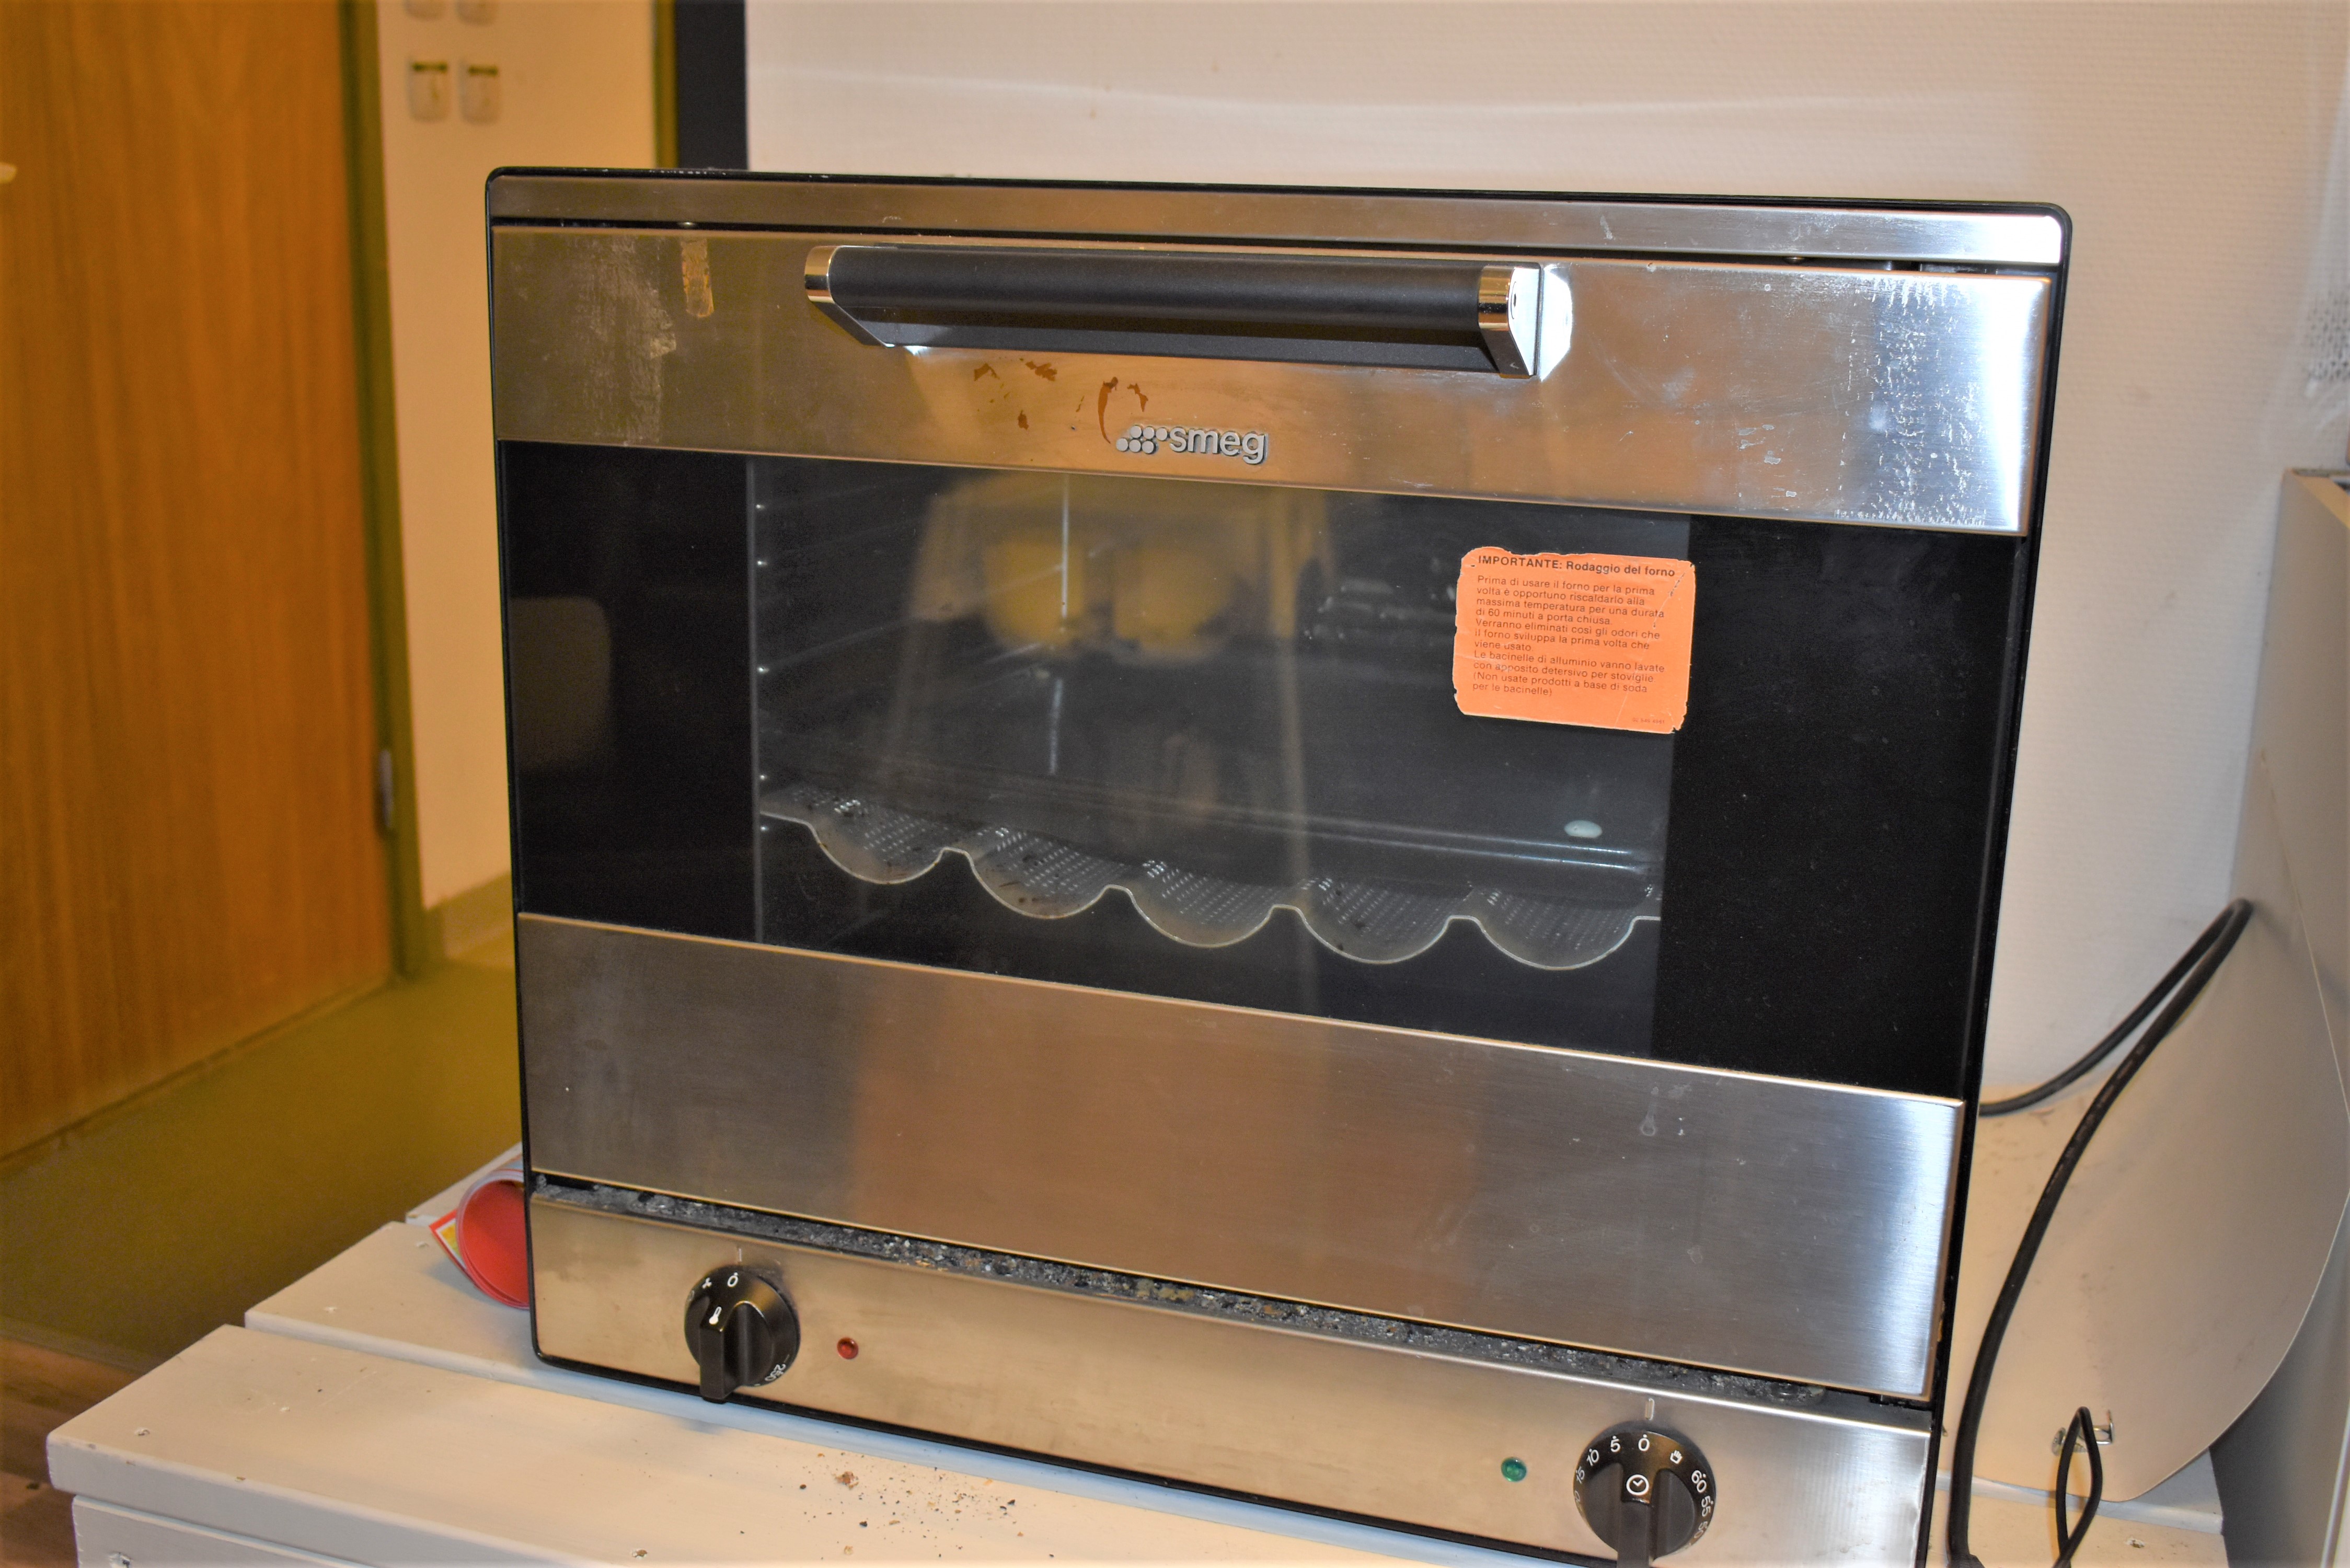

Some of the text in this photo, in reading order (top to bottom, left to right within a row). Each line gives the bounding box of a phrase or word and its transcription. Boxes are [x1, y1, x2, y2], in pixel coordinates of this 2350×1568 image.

[1169, 426, 1268, 465] smeg
[1478, 555, 1675, 577] IMPORTANTE: Rodaggio del forno
[1477, 575, 1506, 585] Prima
[1562, 581, 1589, 591] forno
[1593, 585, 1609, 594] per
[1513, 590, 1566, 599] opportuno
[1570, 593, 1623, 604] riscaldarlo
[1476, 598, 1520, 607] massima
[1524, 601, 1585, 612] temperatura
[1631, 608, 1664, 618] durata
[1488, 608, 1500, 617] 60
[1503, 610, 1534, 619] minuti
[1547, 614, 1573, 622] porta
[1476, 618, 1522, 629] Verranno
[1525, 622, 1568, 632] eliminati
[1595, 627, 1607, 637] gli
[1611, 629, 1638, 637] odori
[1641, 631, 1660, 639] che
[1474, 640, 1500, 649] viene
[1484, 629, 1511, 639] forno
[1514, 631, 1555, 643] sviluppa
[1559, 635, 1567, 643] la
[1571, 637, 1599, 645] prima
[1603, 639, 1627, 648] volta
[1474, 650, 1486, 659] Le
[1489, 651, 1534, 662] bacinelle
[1550, 656, 1597, 667] alluminio
[1634, 662, 1665, 672] lavate
[1495, 664, 1538, 673] apposito
[1542, 666, 1588, 677] detersivo
[1473, 672, 1497, 681] (Non
[1531, 677, 1571, 686] prodotti
[1583, 680, 1607, 689] base
[1623, 684, 1647, 693] soda
[1492, 683, 1500, 691] le
[1504, 685, 1552, 696] bacinelle)
[1610, 1438, 1621, 1452] 5
[1638, 1437, 1650, 1451] 0
[1586, 1449, 1599, 1467] 10
[1575, 1467, 1585, 1484] 15
[1691, 1469, 1707, 1493] 60
[1701, 1495, 1712, 1517] 55
